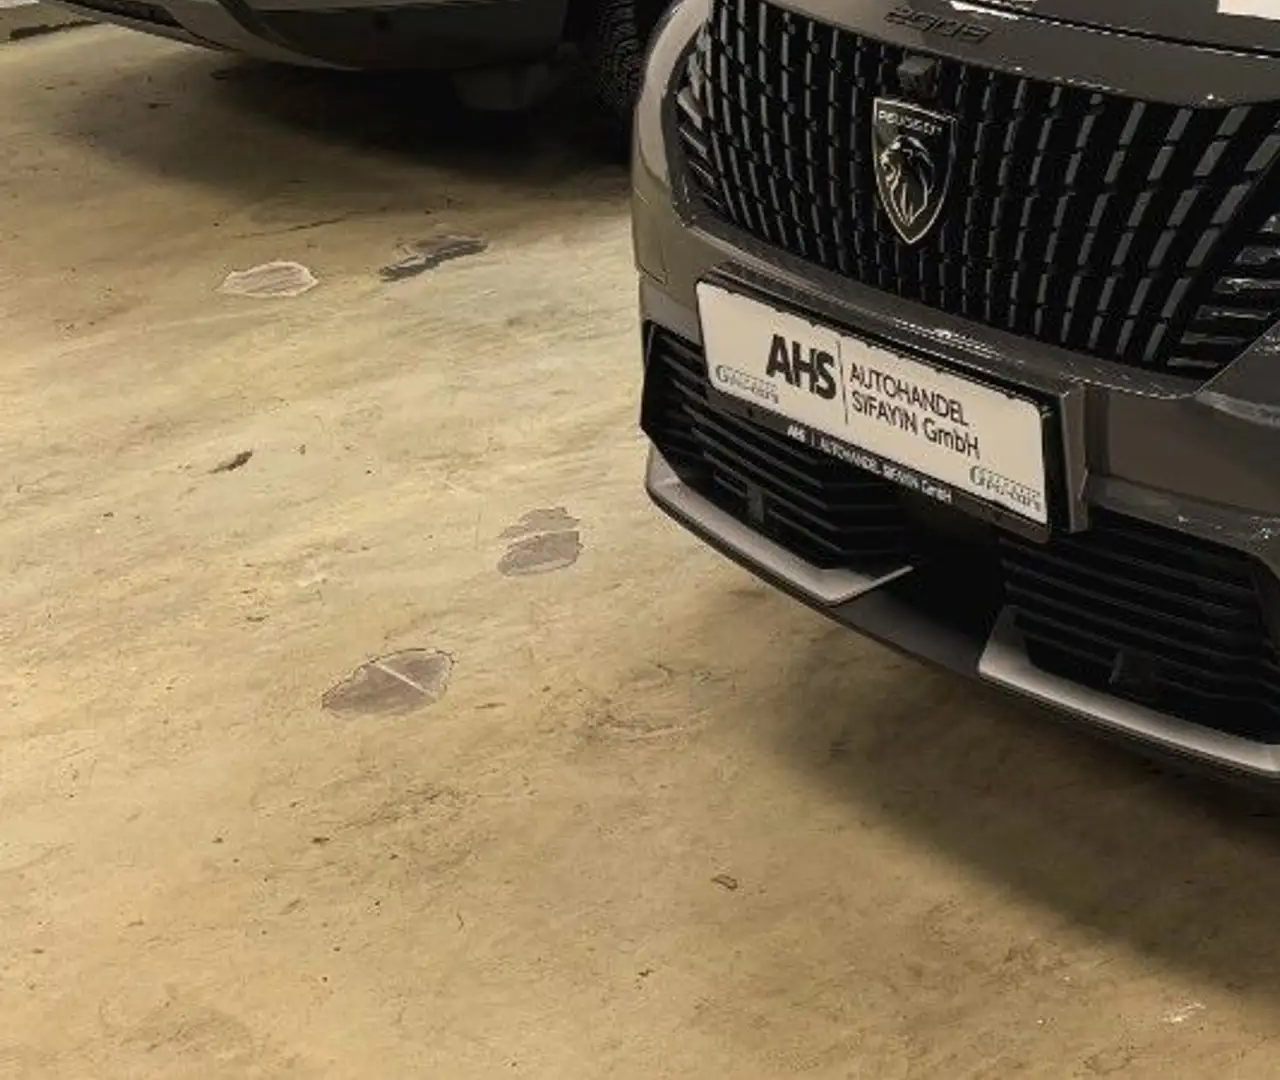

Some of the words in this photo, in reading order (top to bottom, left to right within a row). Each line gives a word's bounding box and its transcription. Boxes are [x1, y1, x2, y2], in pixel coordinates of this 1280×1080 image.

[766, 334, 837, 400] AHS
[850, 362, 969, 426] AUTOHANDEL
[852, 390, 918, 435] SIFAYIN
[922, 417, 980, 460] GmbH
